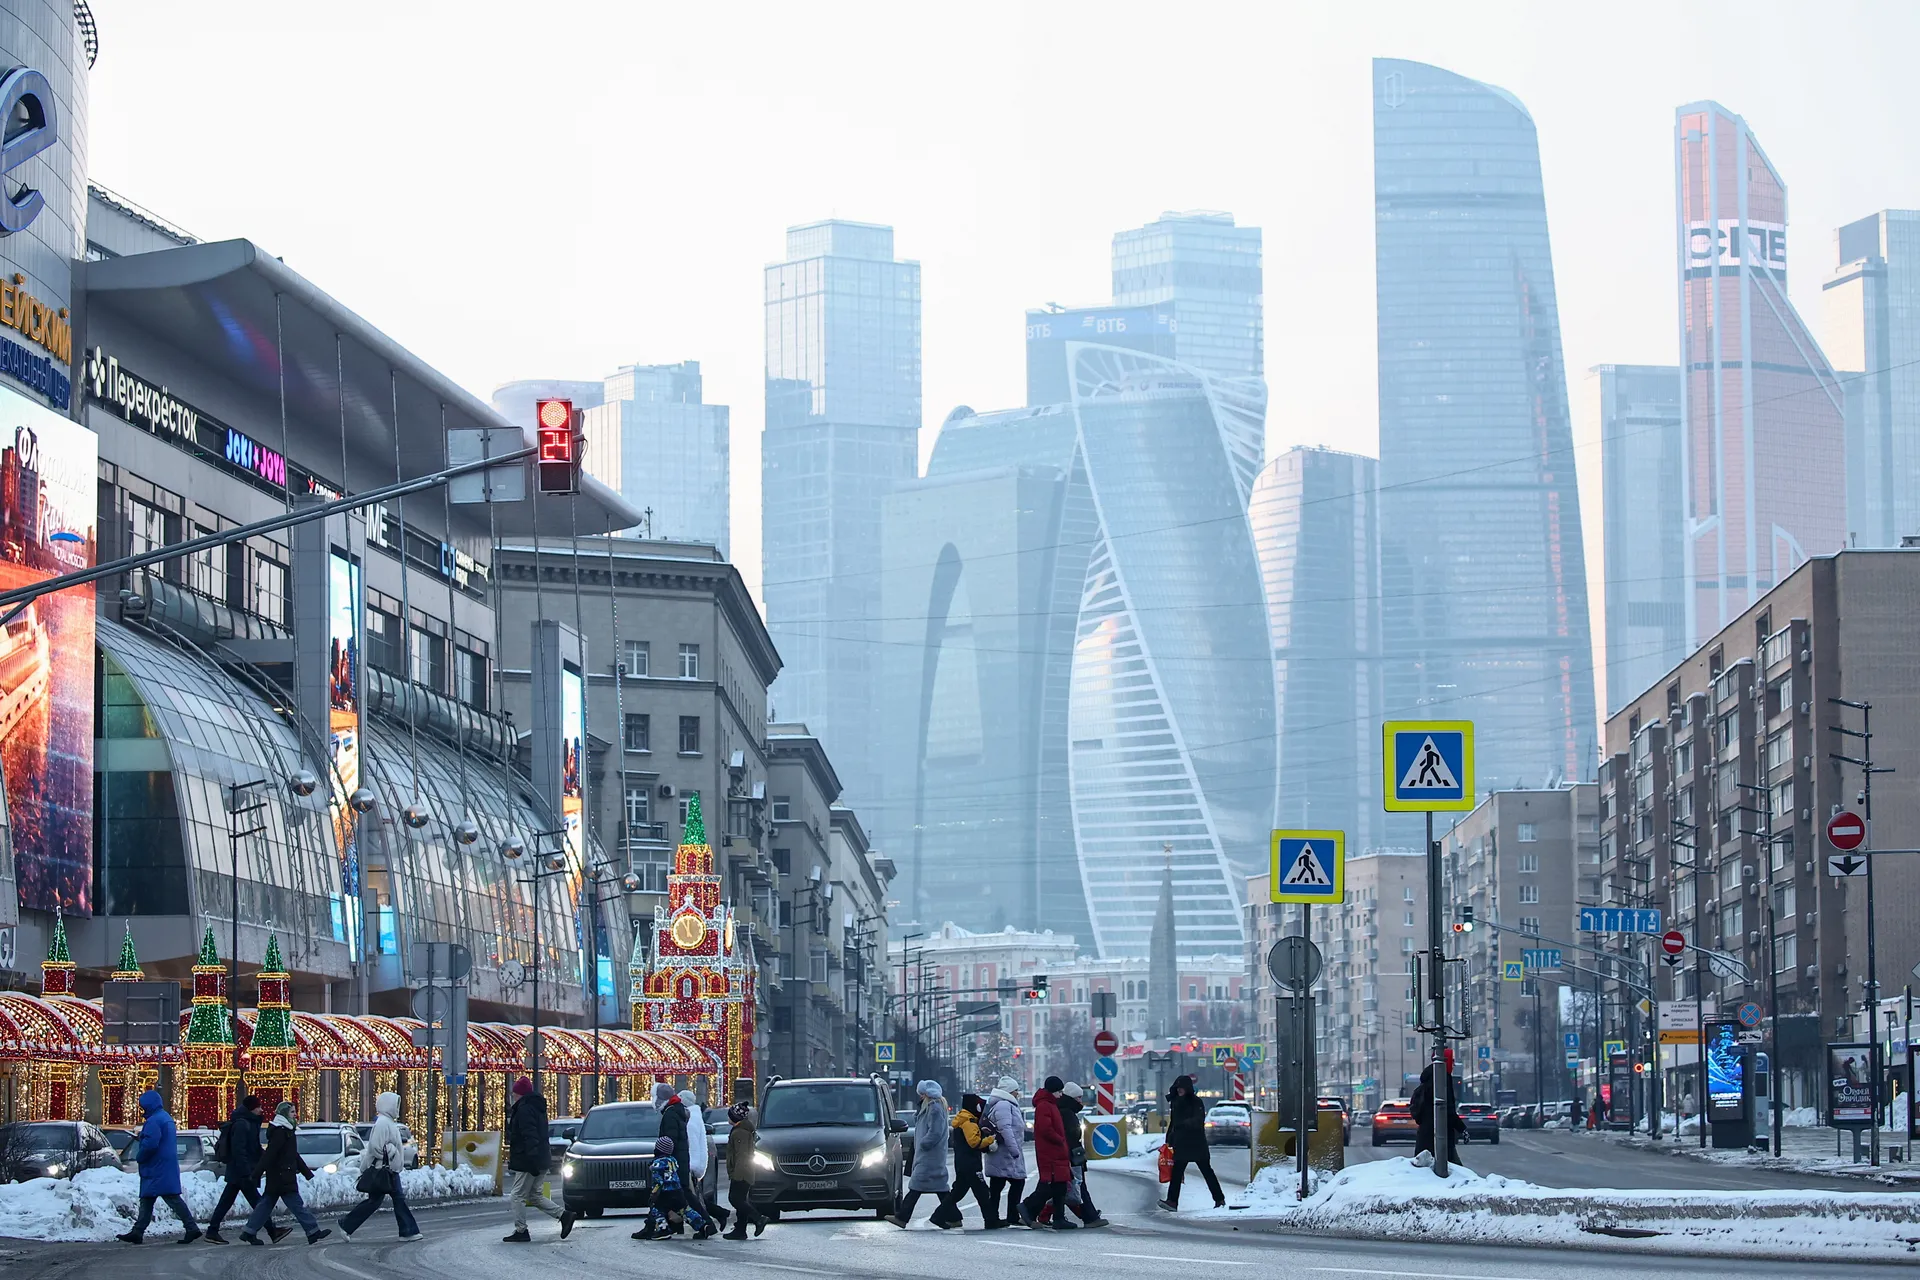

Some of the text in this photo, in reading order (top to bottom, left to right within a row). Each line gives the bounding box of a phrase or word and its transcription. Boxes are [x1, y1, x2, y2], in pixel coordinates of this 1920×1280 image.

[1026, 324, 1051, 340] ВТБ
[1097, 317, 1127, 333] ВТБ
[108, 355, 199, 444] Перекрёсток
[225, 428, 286, 487] JOKI JOYA
[543, 432, 569, 459] 24
